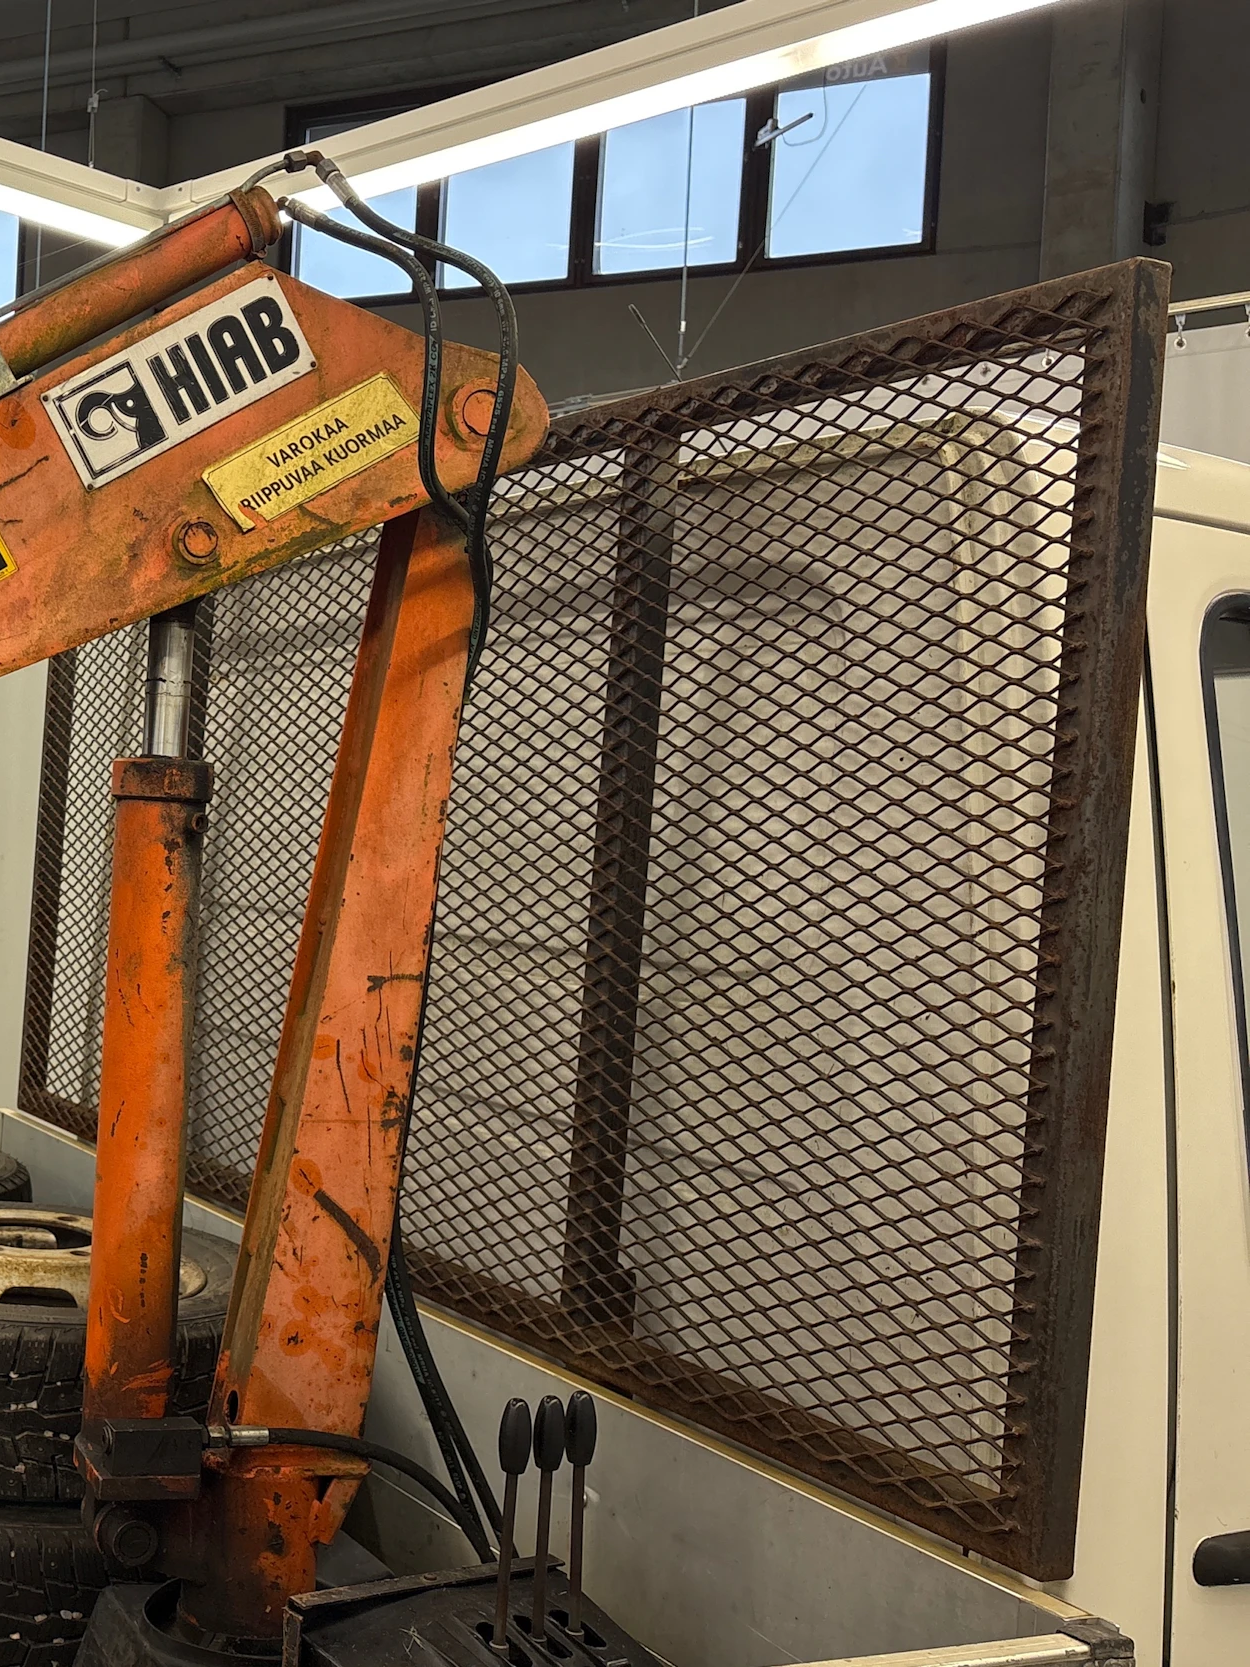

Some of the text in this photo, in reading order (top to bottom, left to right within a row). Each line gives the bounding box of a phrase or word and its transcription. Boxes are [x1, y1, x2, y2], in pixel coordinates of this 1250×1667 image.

[145, 296, 300, 425] HIAB
[239, 460, 326, 511] RIIPPUVAA
[323, 413, 407, 466] KUORMAA
[266, 417, 350, 468] VAROKAA
